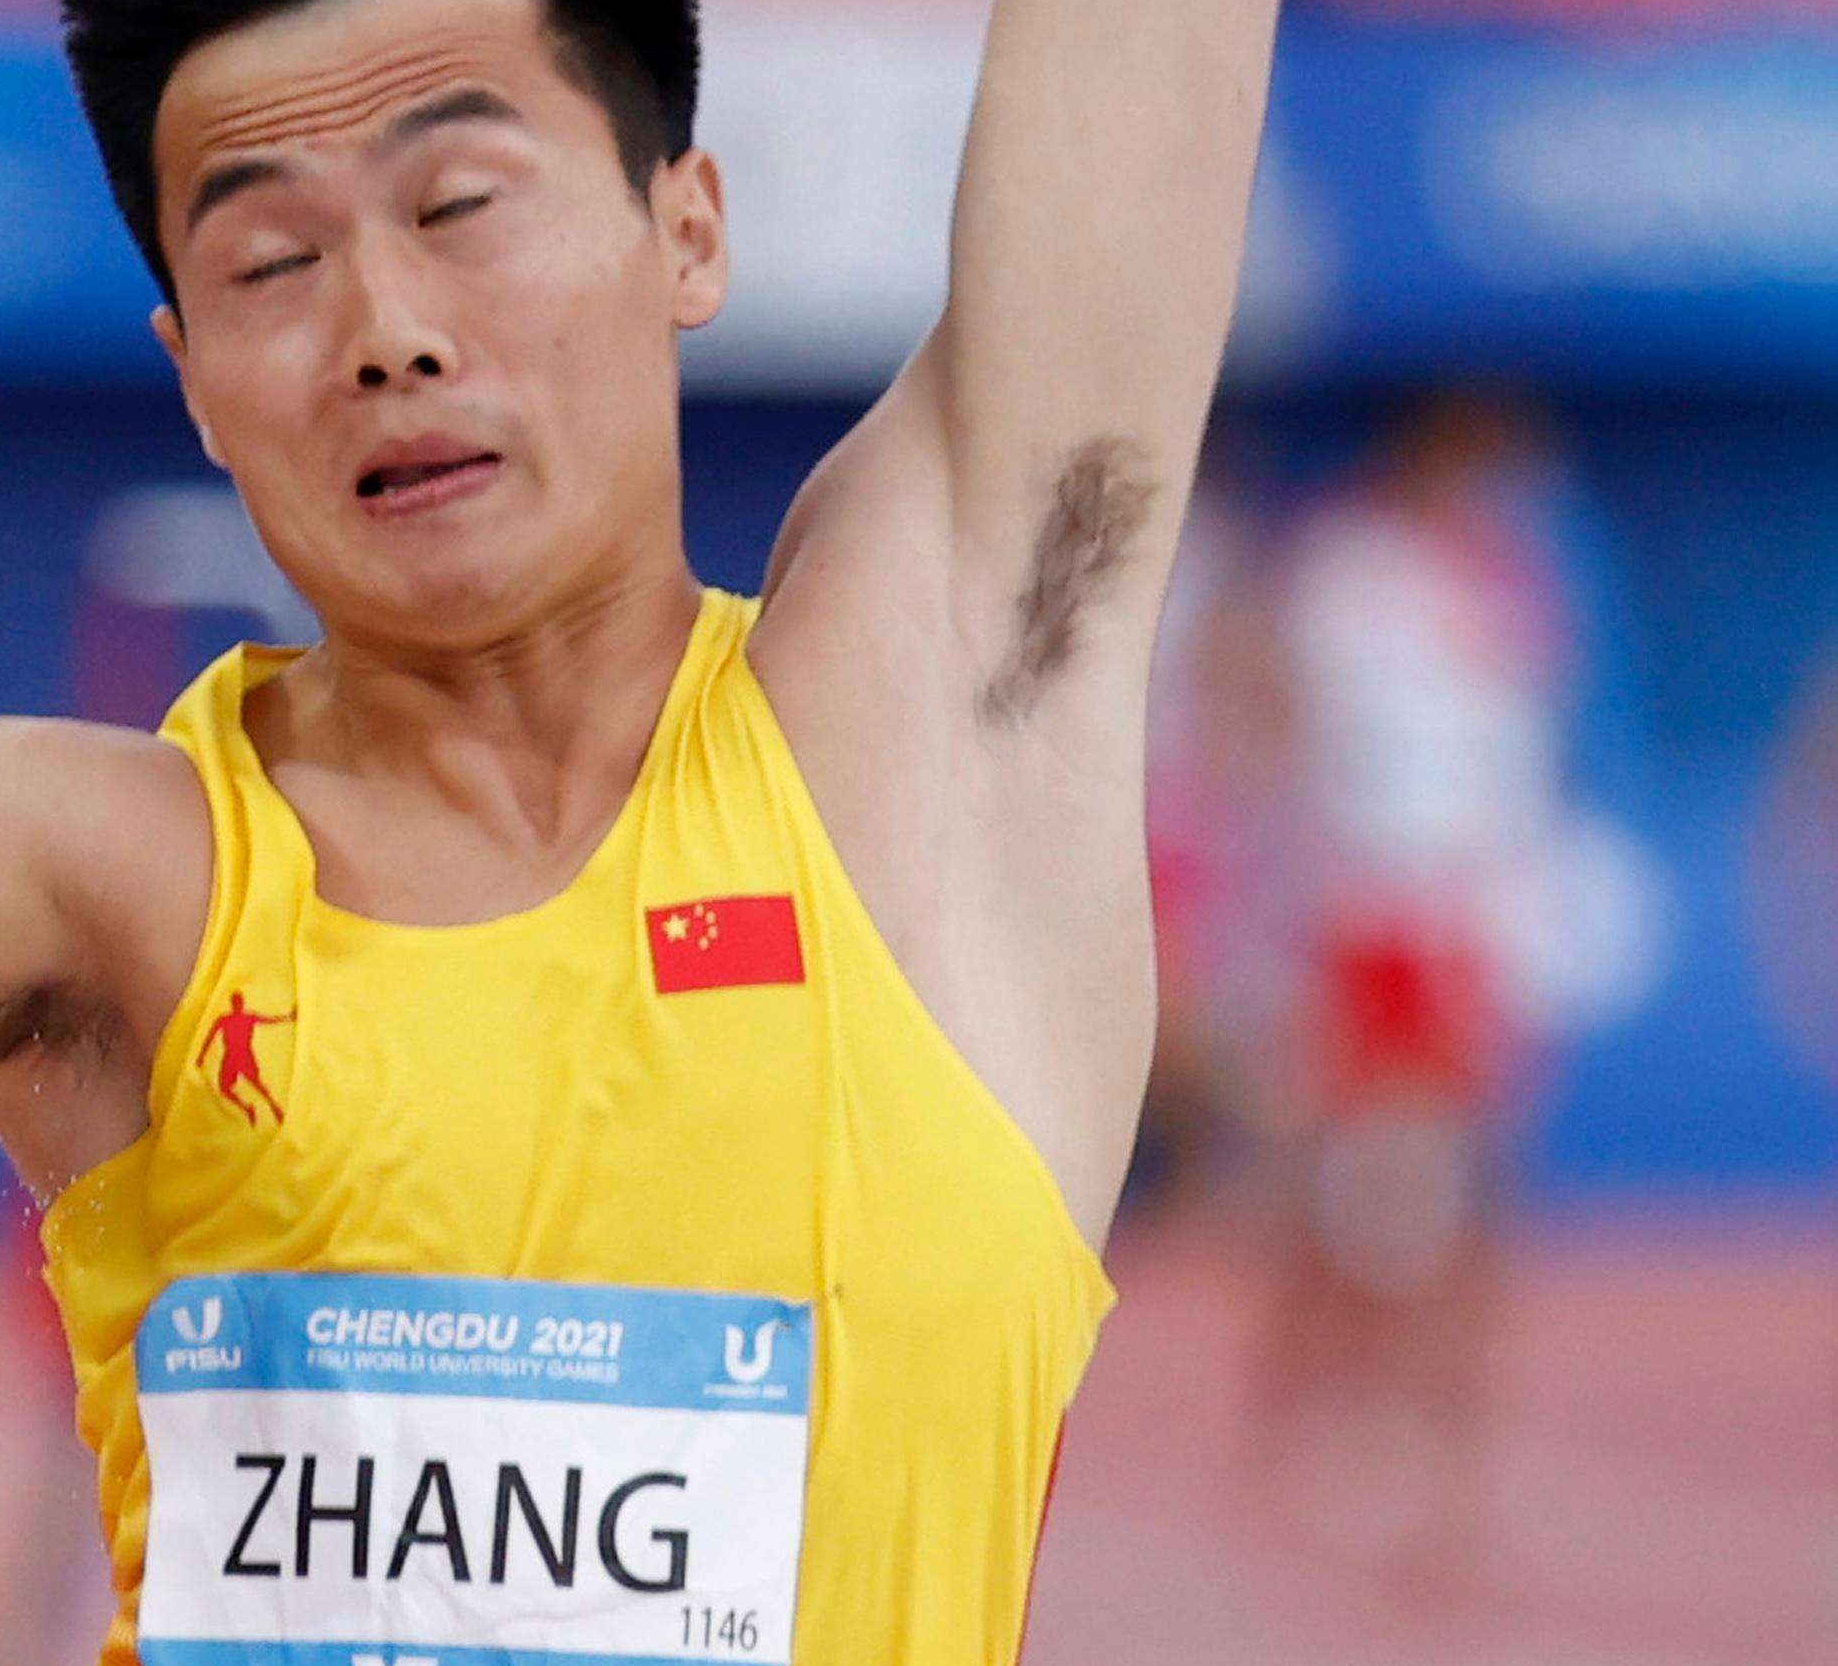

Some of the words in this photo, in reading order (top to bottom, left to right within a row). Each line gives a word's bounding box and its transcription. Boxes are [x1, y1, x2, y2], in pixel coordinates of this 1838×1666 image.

[306, 1306, 519, 1353] CHENGDU
[529, 1316, 624, 1358] 2021
[166, 1346, 242, 1373] FISU
[353, 1350, 425, 1374] WORLD
[428, 1353, 545, 1379] UNIVERSITY
[546, 1358, 619, 1384] GAMES
[223, 1453, 689, 1595] ZHANG
[681, 1606, 759, 1651] 1146
